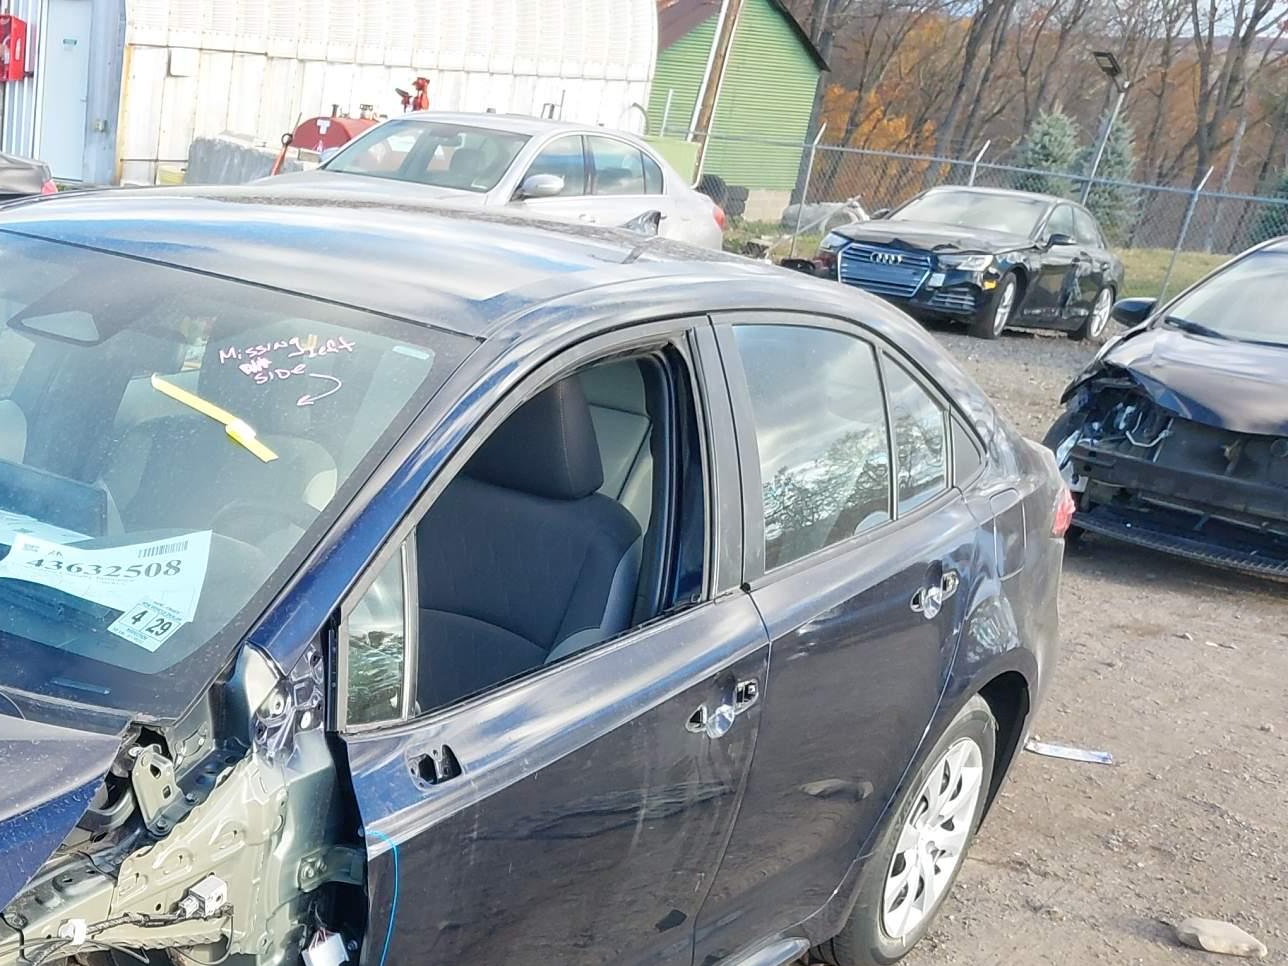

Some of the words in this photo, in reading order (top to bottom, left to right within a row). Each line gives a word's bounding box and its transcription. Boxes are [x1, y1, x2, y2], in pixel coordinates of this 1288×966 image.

[25, 558, 182, 579] 43632508
[131, 609, 148, 625] 4
[145, 618, 173, 636] 29
